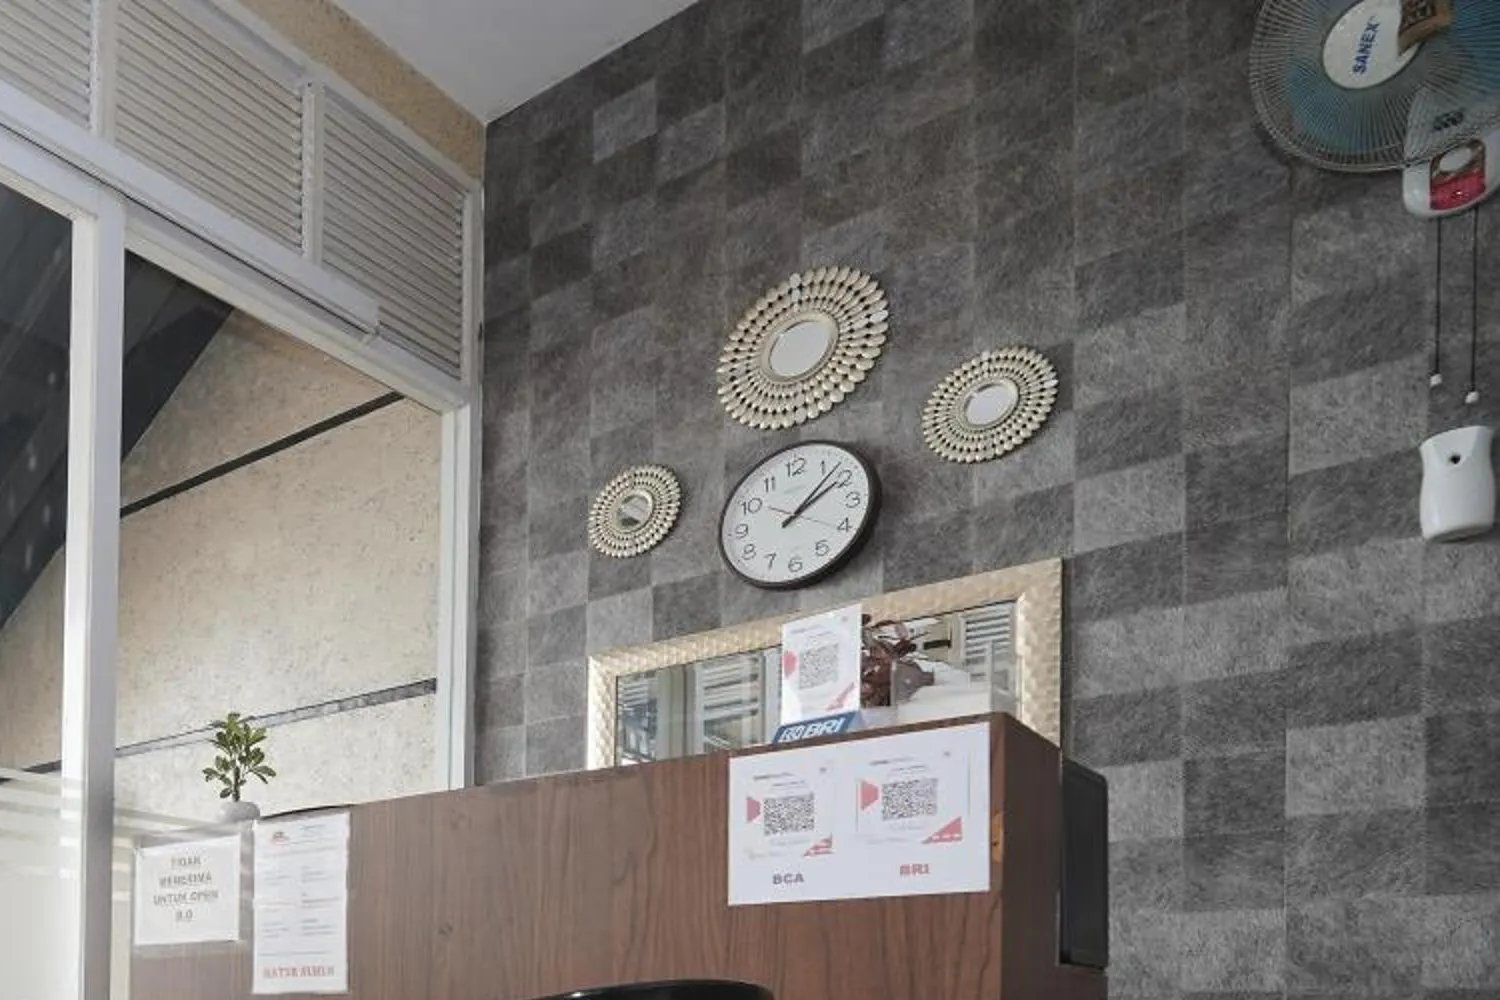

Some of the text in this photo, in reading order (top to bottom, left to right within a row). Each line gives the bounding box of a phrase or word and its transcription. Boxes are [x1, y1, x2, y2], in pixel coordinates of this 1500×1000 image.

[1352, 21, 1381, 74] SANEX
[785, 457, 806, 477] 12
[820, 459, 826, 474] 1
[763, 476, 776, 492] 11
[836, 469, 853, 488] 2
[741, 497, 763, 516] 10
[846, 492, 861, 508] 3
[735, 523, 749, 538] 9
[837, 517, 853, 534] 4
[742, 543, 757, 561] 8
[815, 540, 831, 557] 5
[764, 553, 777, 570] 7
[788, 556, 803, 573] 6
[804, 718, 846, 736] BRI
[899, 863, 931, 876] BRI
[772, 873, 805, 885] BCA
